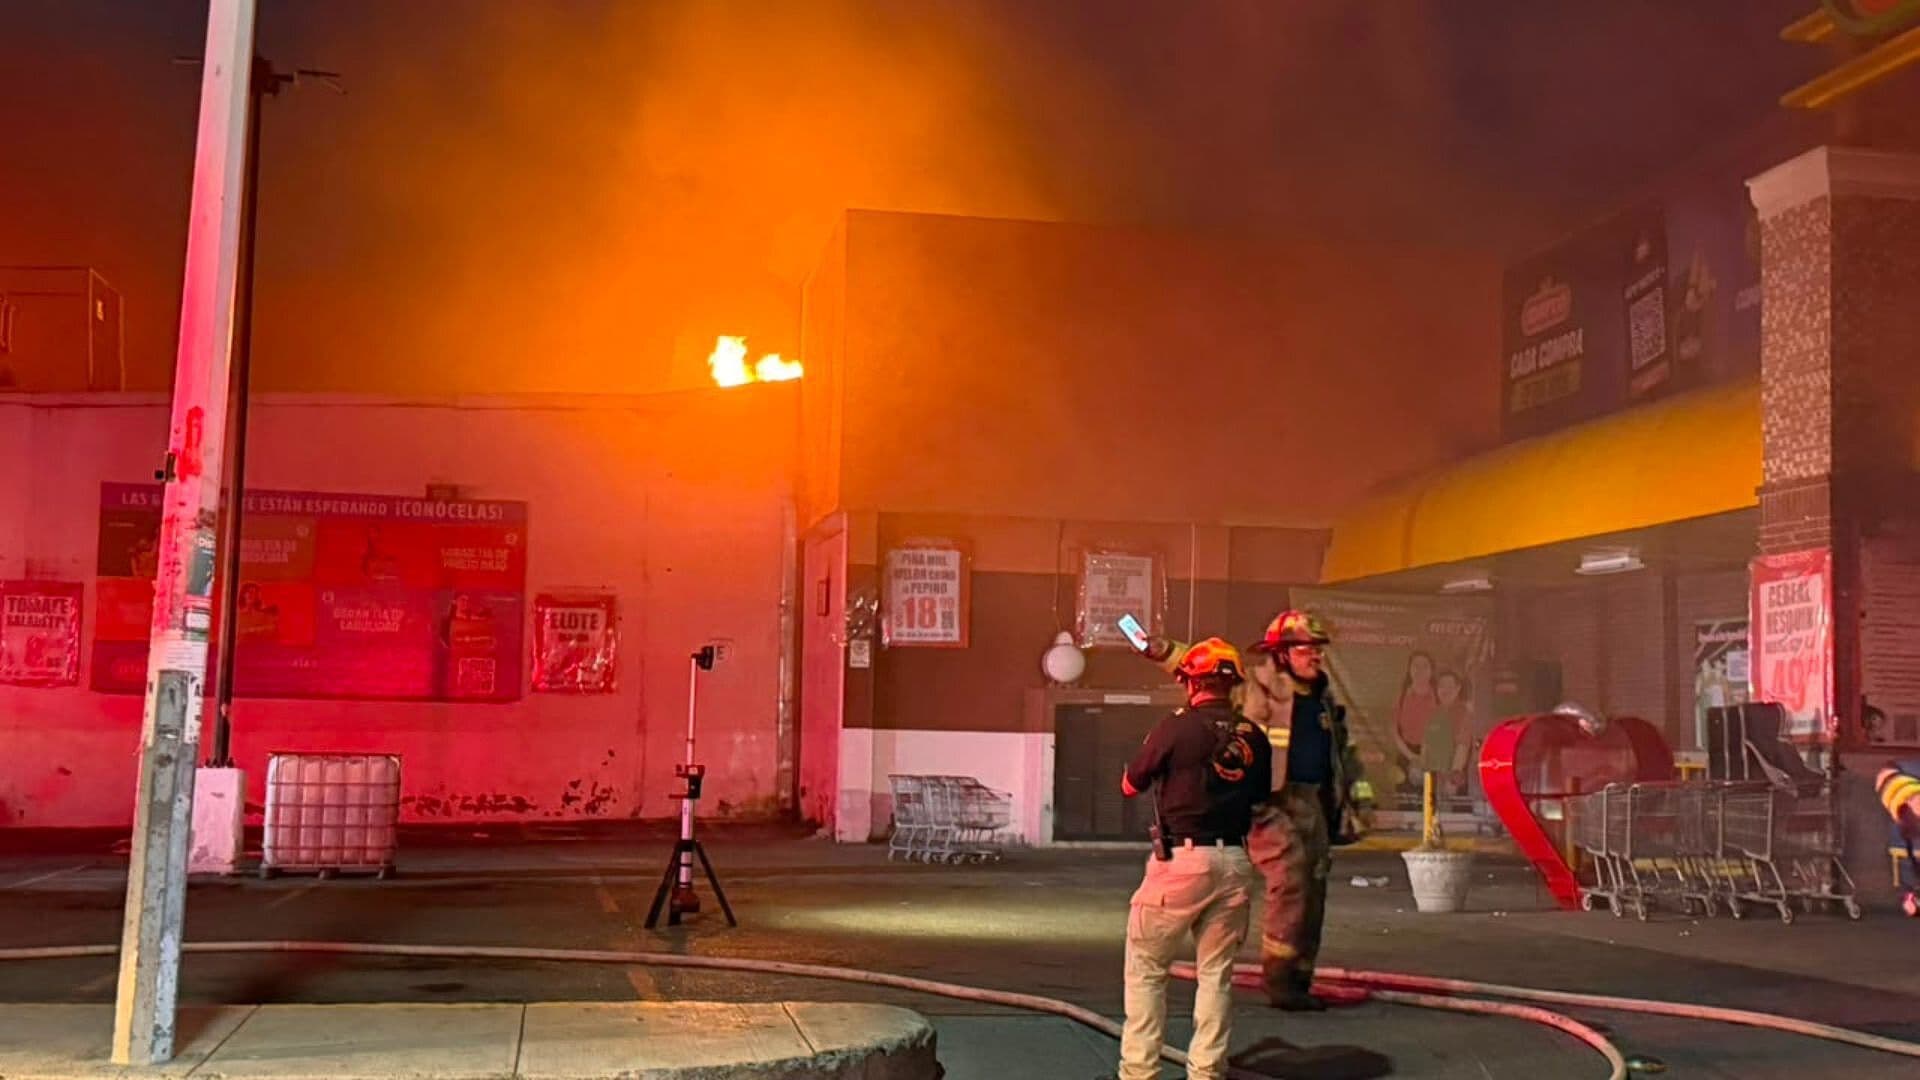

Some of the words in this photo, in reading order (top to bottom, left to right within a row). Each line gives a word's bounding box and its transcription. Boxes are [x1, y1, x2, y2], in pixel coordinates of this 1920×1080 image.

[122, 492, 147, 505] LAS
[306, 499, 388, 517] ESPERANDO
[911, 582, 948, 594] PEPINO
[8, 597, 69, 614] TOMATE
[551, 611, 599, 630] ELOTE
[1766, 606, 1814, 635] NESQUIK
